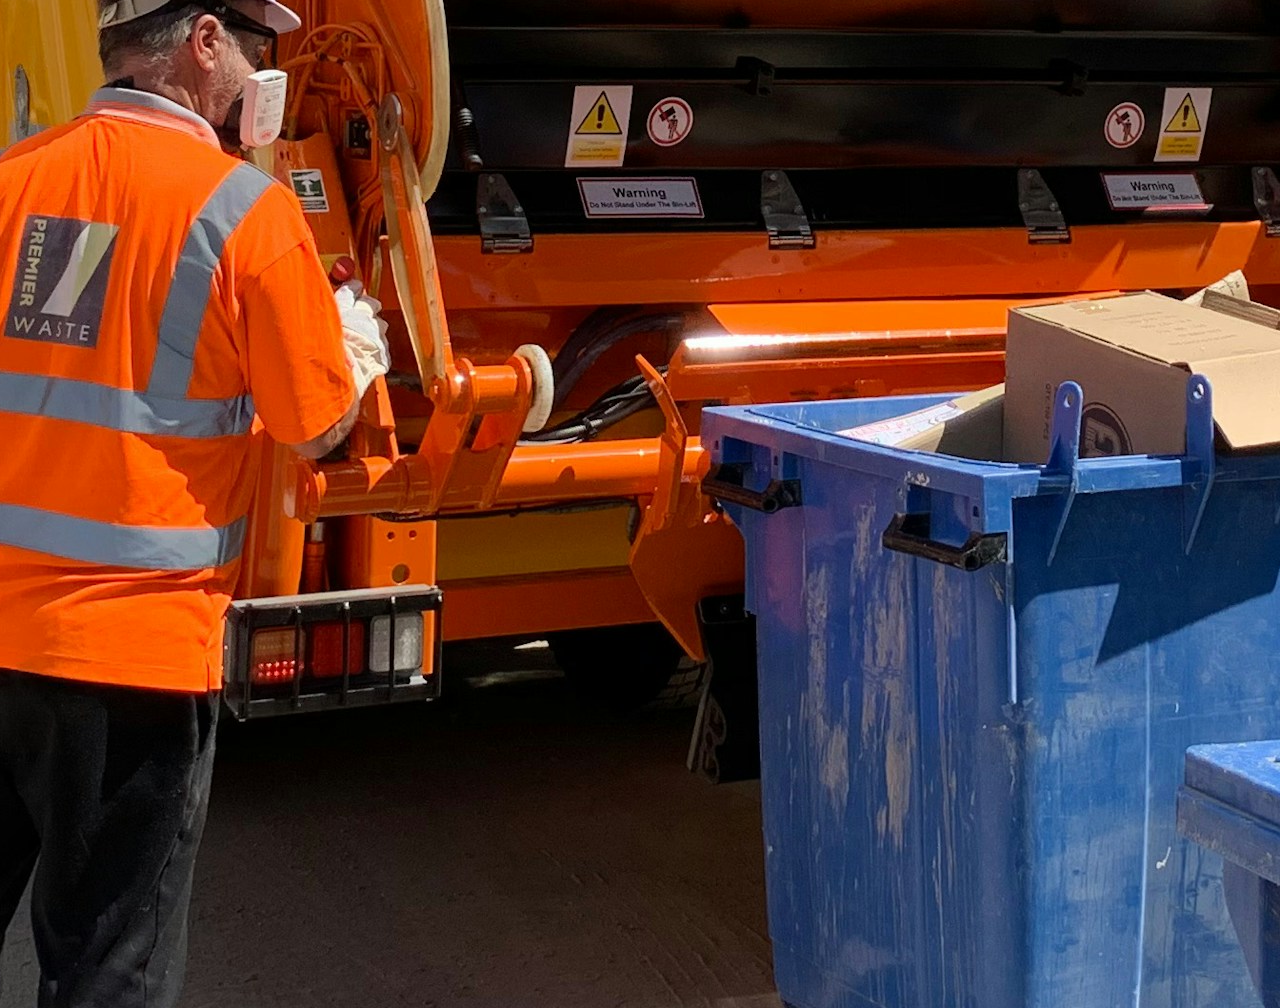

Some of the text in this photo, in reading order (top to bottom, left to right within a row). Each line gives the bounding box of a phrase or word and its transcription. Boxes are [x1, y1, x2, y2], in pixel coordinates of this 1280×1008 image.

[612, 187, 667, 199] Warning
[1129, 180, 1176, 192] Warning
[19, 218, 47, 307] PREMIER
[14, 317, 90, 342] WASTE
